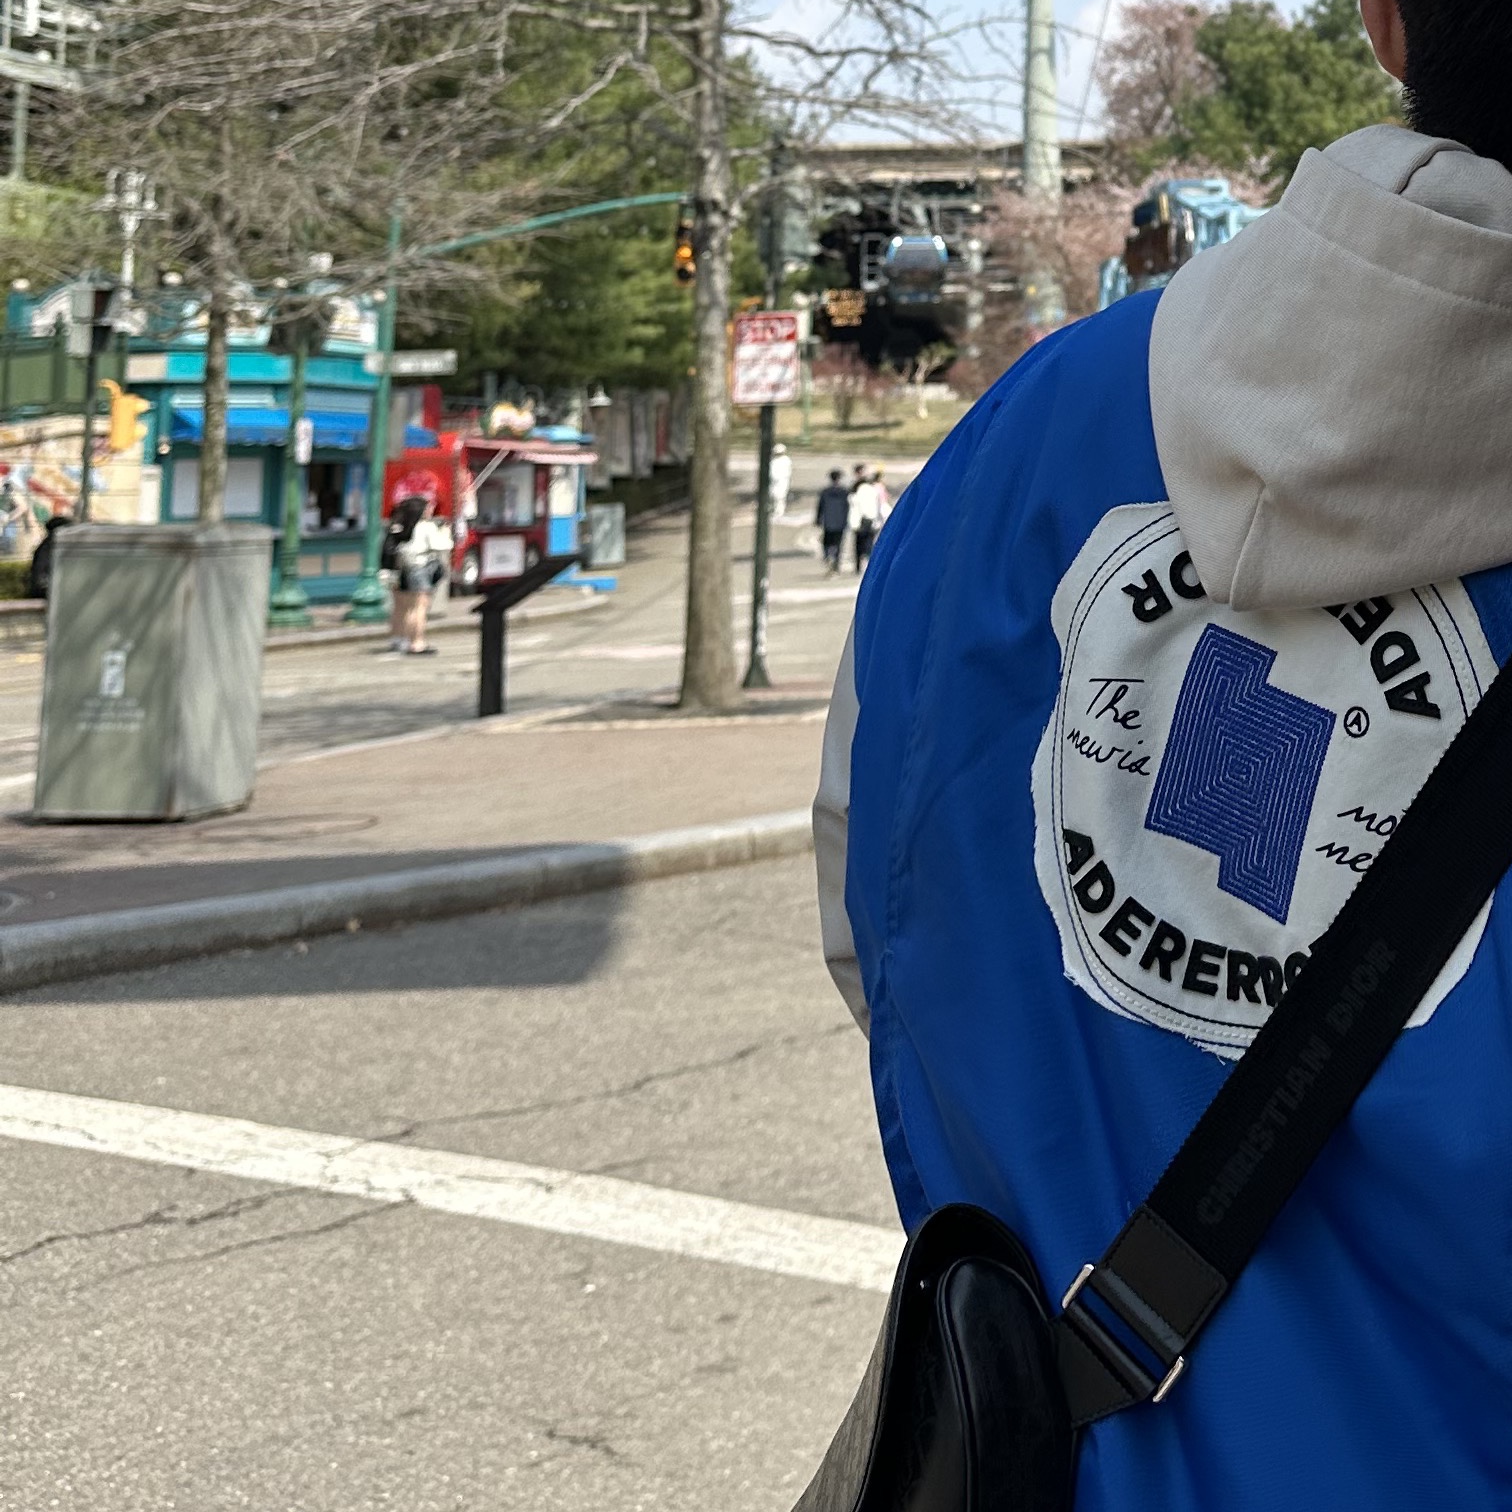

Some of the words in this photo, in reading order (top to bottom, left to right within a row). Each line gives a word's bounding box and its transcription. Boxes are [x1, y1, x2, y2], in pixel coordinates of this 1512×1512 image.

[739, 318, 796, 343] STOP
[1086, 678, 1145, 730] The
[1067, 728, 1124, 763] new
[1337, 806, 1407, 836] no
[1315, 842, 1373, 873] ne
[1062, 828, 1314, 1007] ADERERRO
[1198, 1035, 1332, 1224] CHRISTIAN
[1327, 940, 1397, 1035] DIOR
